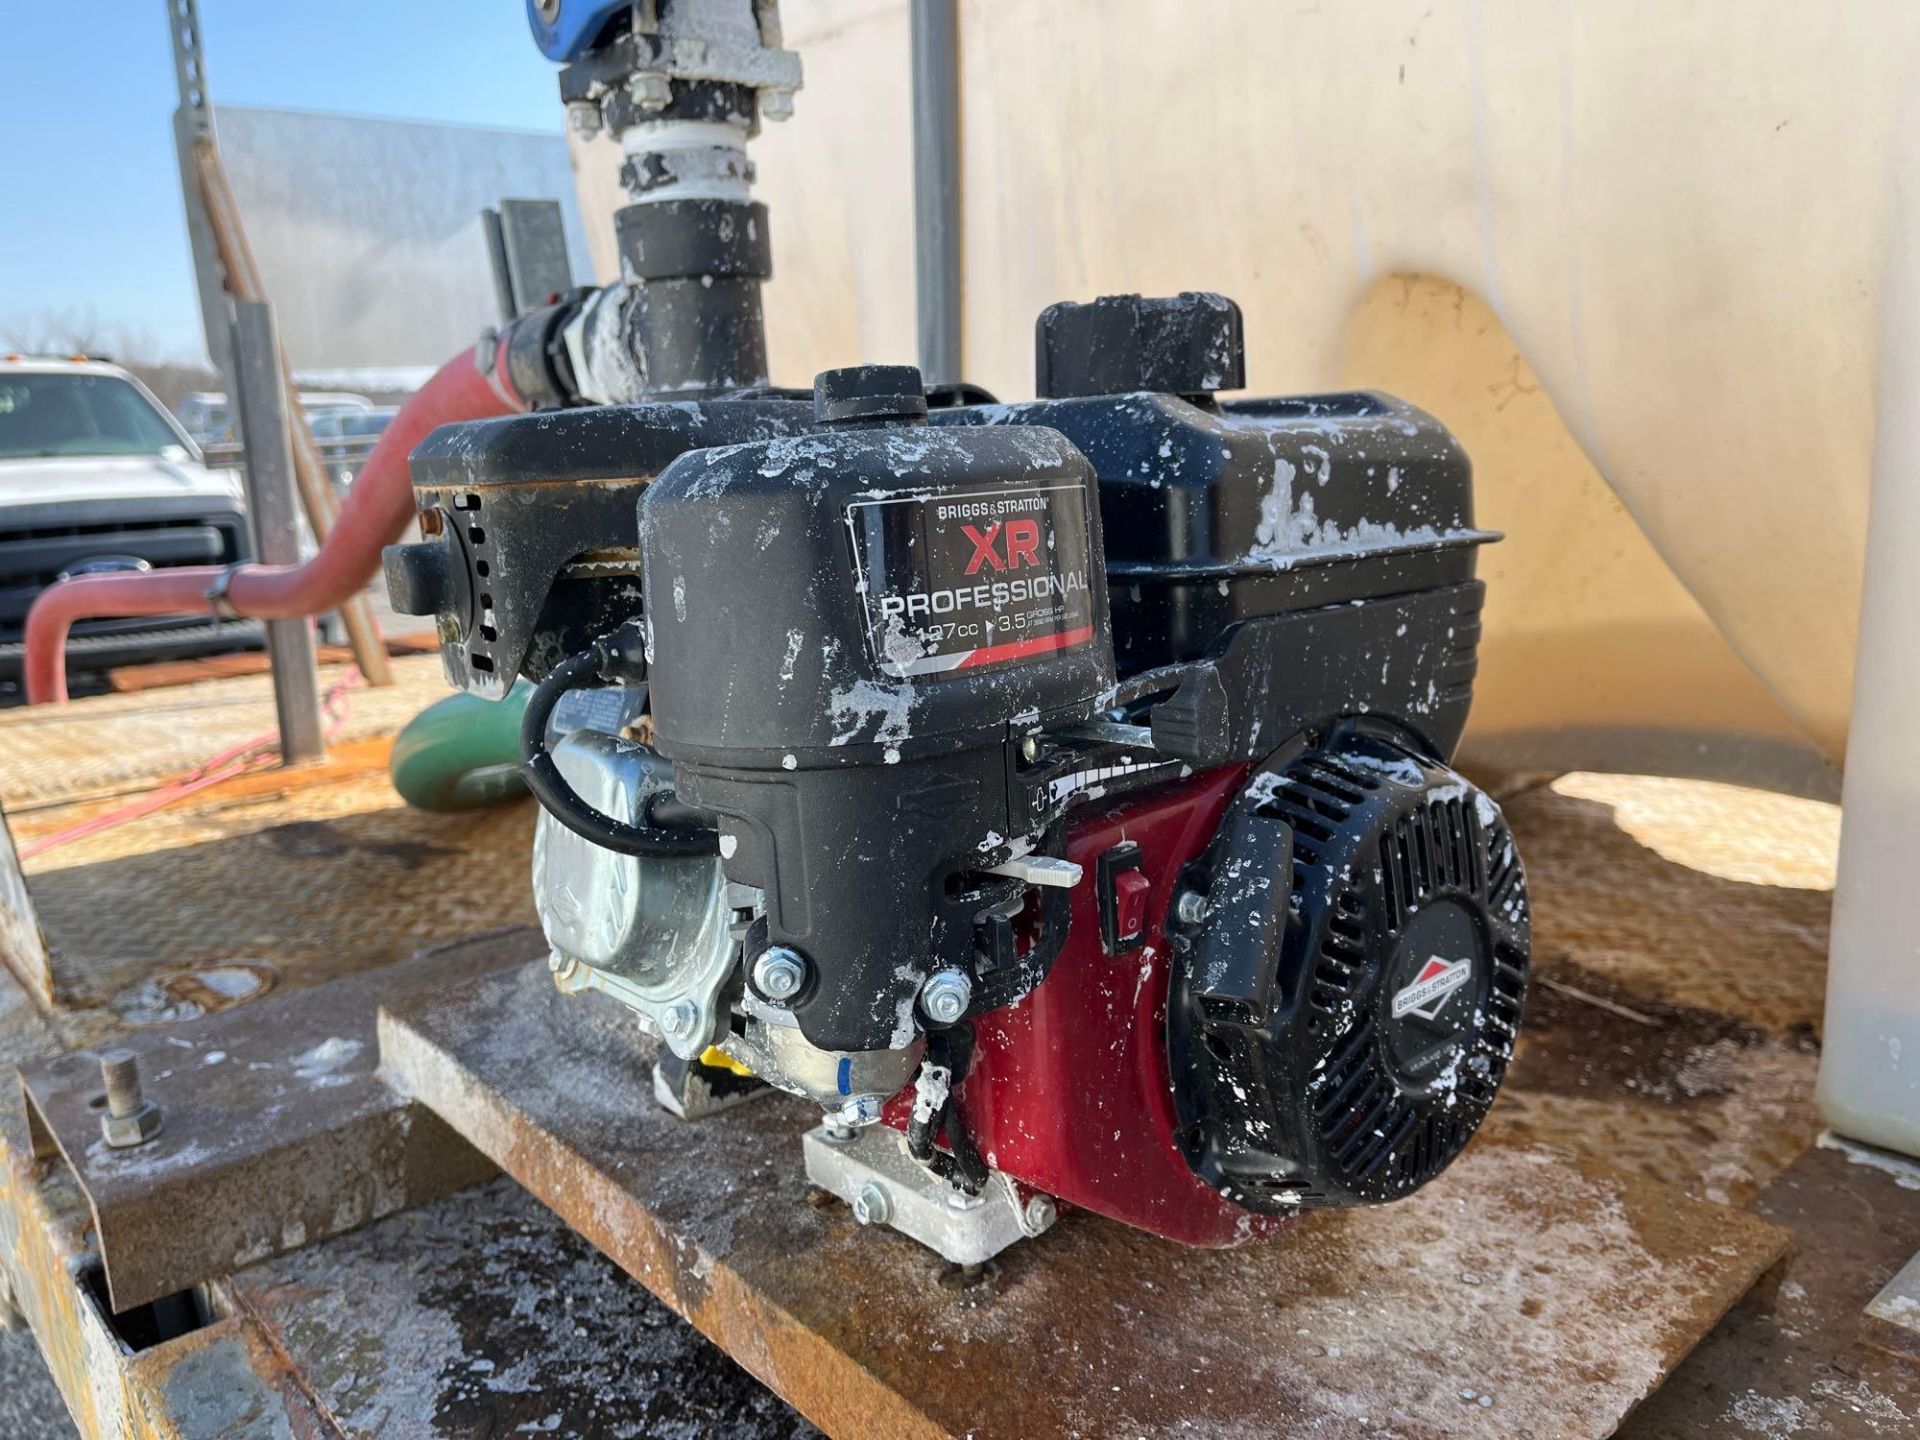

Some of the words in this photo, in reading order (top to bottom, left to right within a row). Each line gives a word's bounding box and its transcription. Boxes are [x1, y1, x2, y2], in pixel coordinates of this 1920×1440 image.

[938, 498, 1047, 519] BRIGGS&STRATTON
[960, 519, 1040, 575] XR
[881, 571, 1088, 620] PROFESSIONAL
[998, 613, 1026, 632] 3.5
[1026, 607, 1053, 619] GROSS
[1055, 605, 1065, 614] HP
[1397, 967, 1467, 1011] BRIGGS&STRATTON
